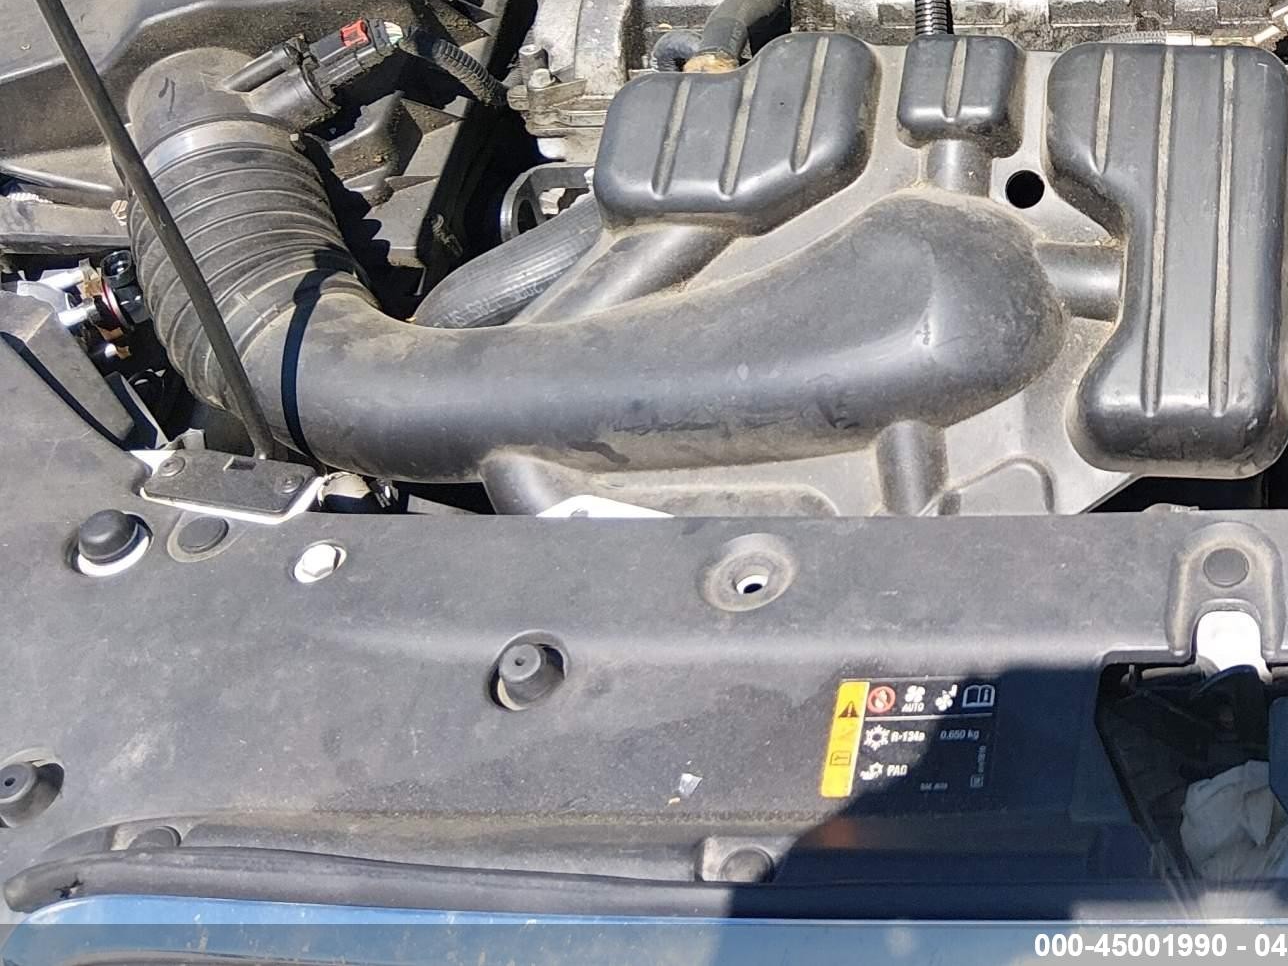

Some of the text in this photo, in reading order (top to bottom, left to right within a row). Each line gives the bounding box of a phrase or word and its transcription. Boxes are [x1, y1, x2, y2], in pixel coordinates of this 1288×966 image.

[901, 702, 925, 712] AUTO
[890, 730, 926, 743] R-134a
[967, 729, 980, 740] kg
[887, 764, 908, 777] PAG
